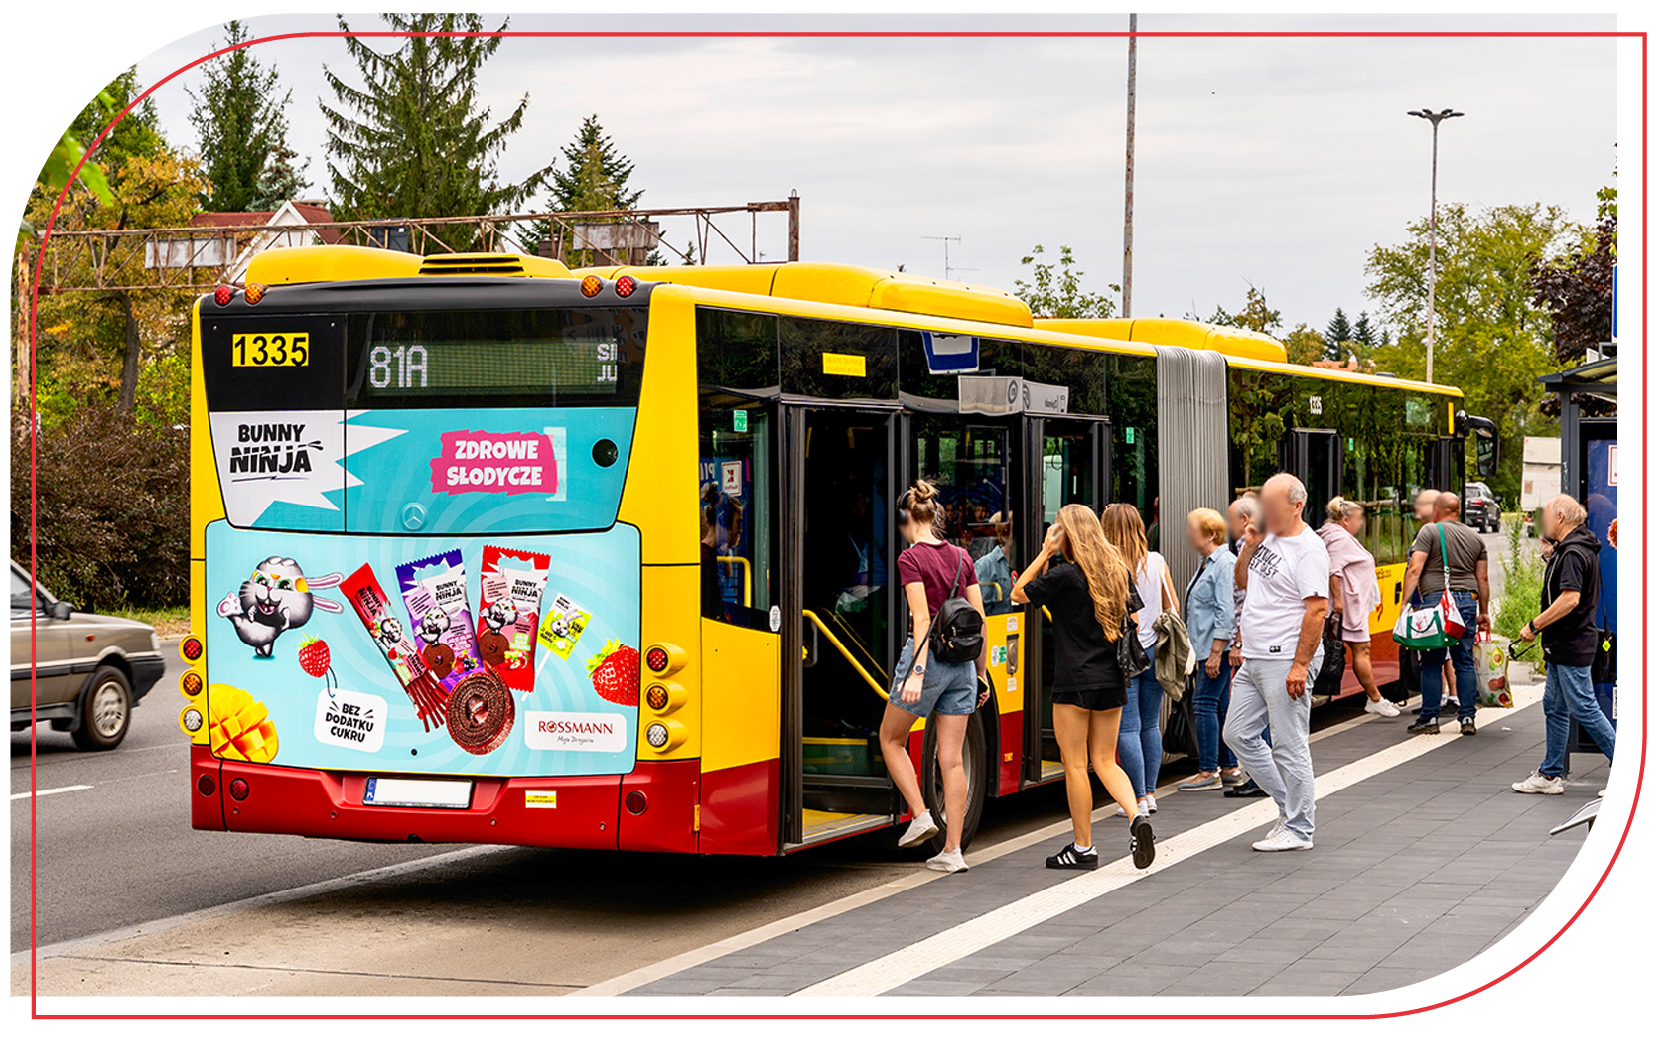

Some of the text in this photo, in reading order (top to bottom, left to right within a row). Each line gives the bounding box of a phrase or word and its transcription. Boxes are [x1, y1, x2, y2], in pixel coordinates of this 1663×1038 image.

[234, 335, 307, 366] 1335
[369, 345, 428, 388] 81A
[238, 424, 306, 442] BUNNY
[455, 440, 539, 459] ZDROWE
[229, 445, 312, 473] NINJA
[446, 466, 543, 486] SŁODYCZE
[436, 580, 458, 591] BUNNY
[511, 586, 538, 598] NINJA
[514, 579, 538, 588] BUNNY
[356, 586, 378, 617] NINJA
[435, 587, 463, 602] NINJA
[342, 703, 361, 717] BEZ
[325, 712, 374, 732] DODATKU
[538, 720, 613, 734] ROSSMANN
[330, 726, 365, 743] CUKRU
